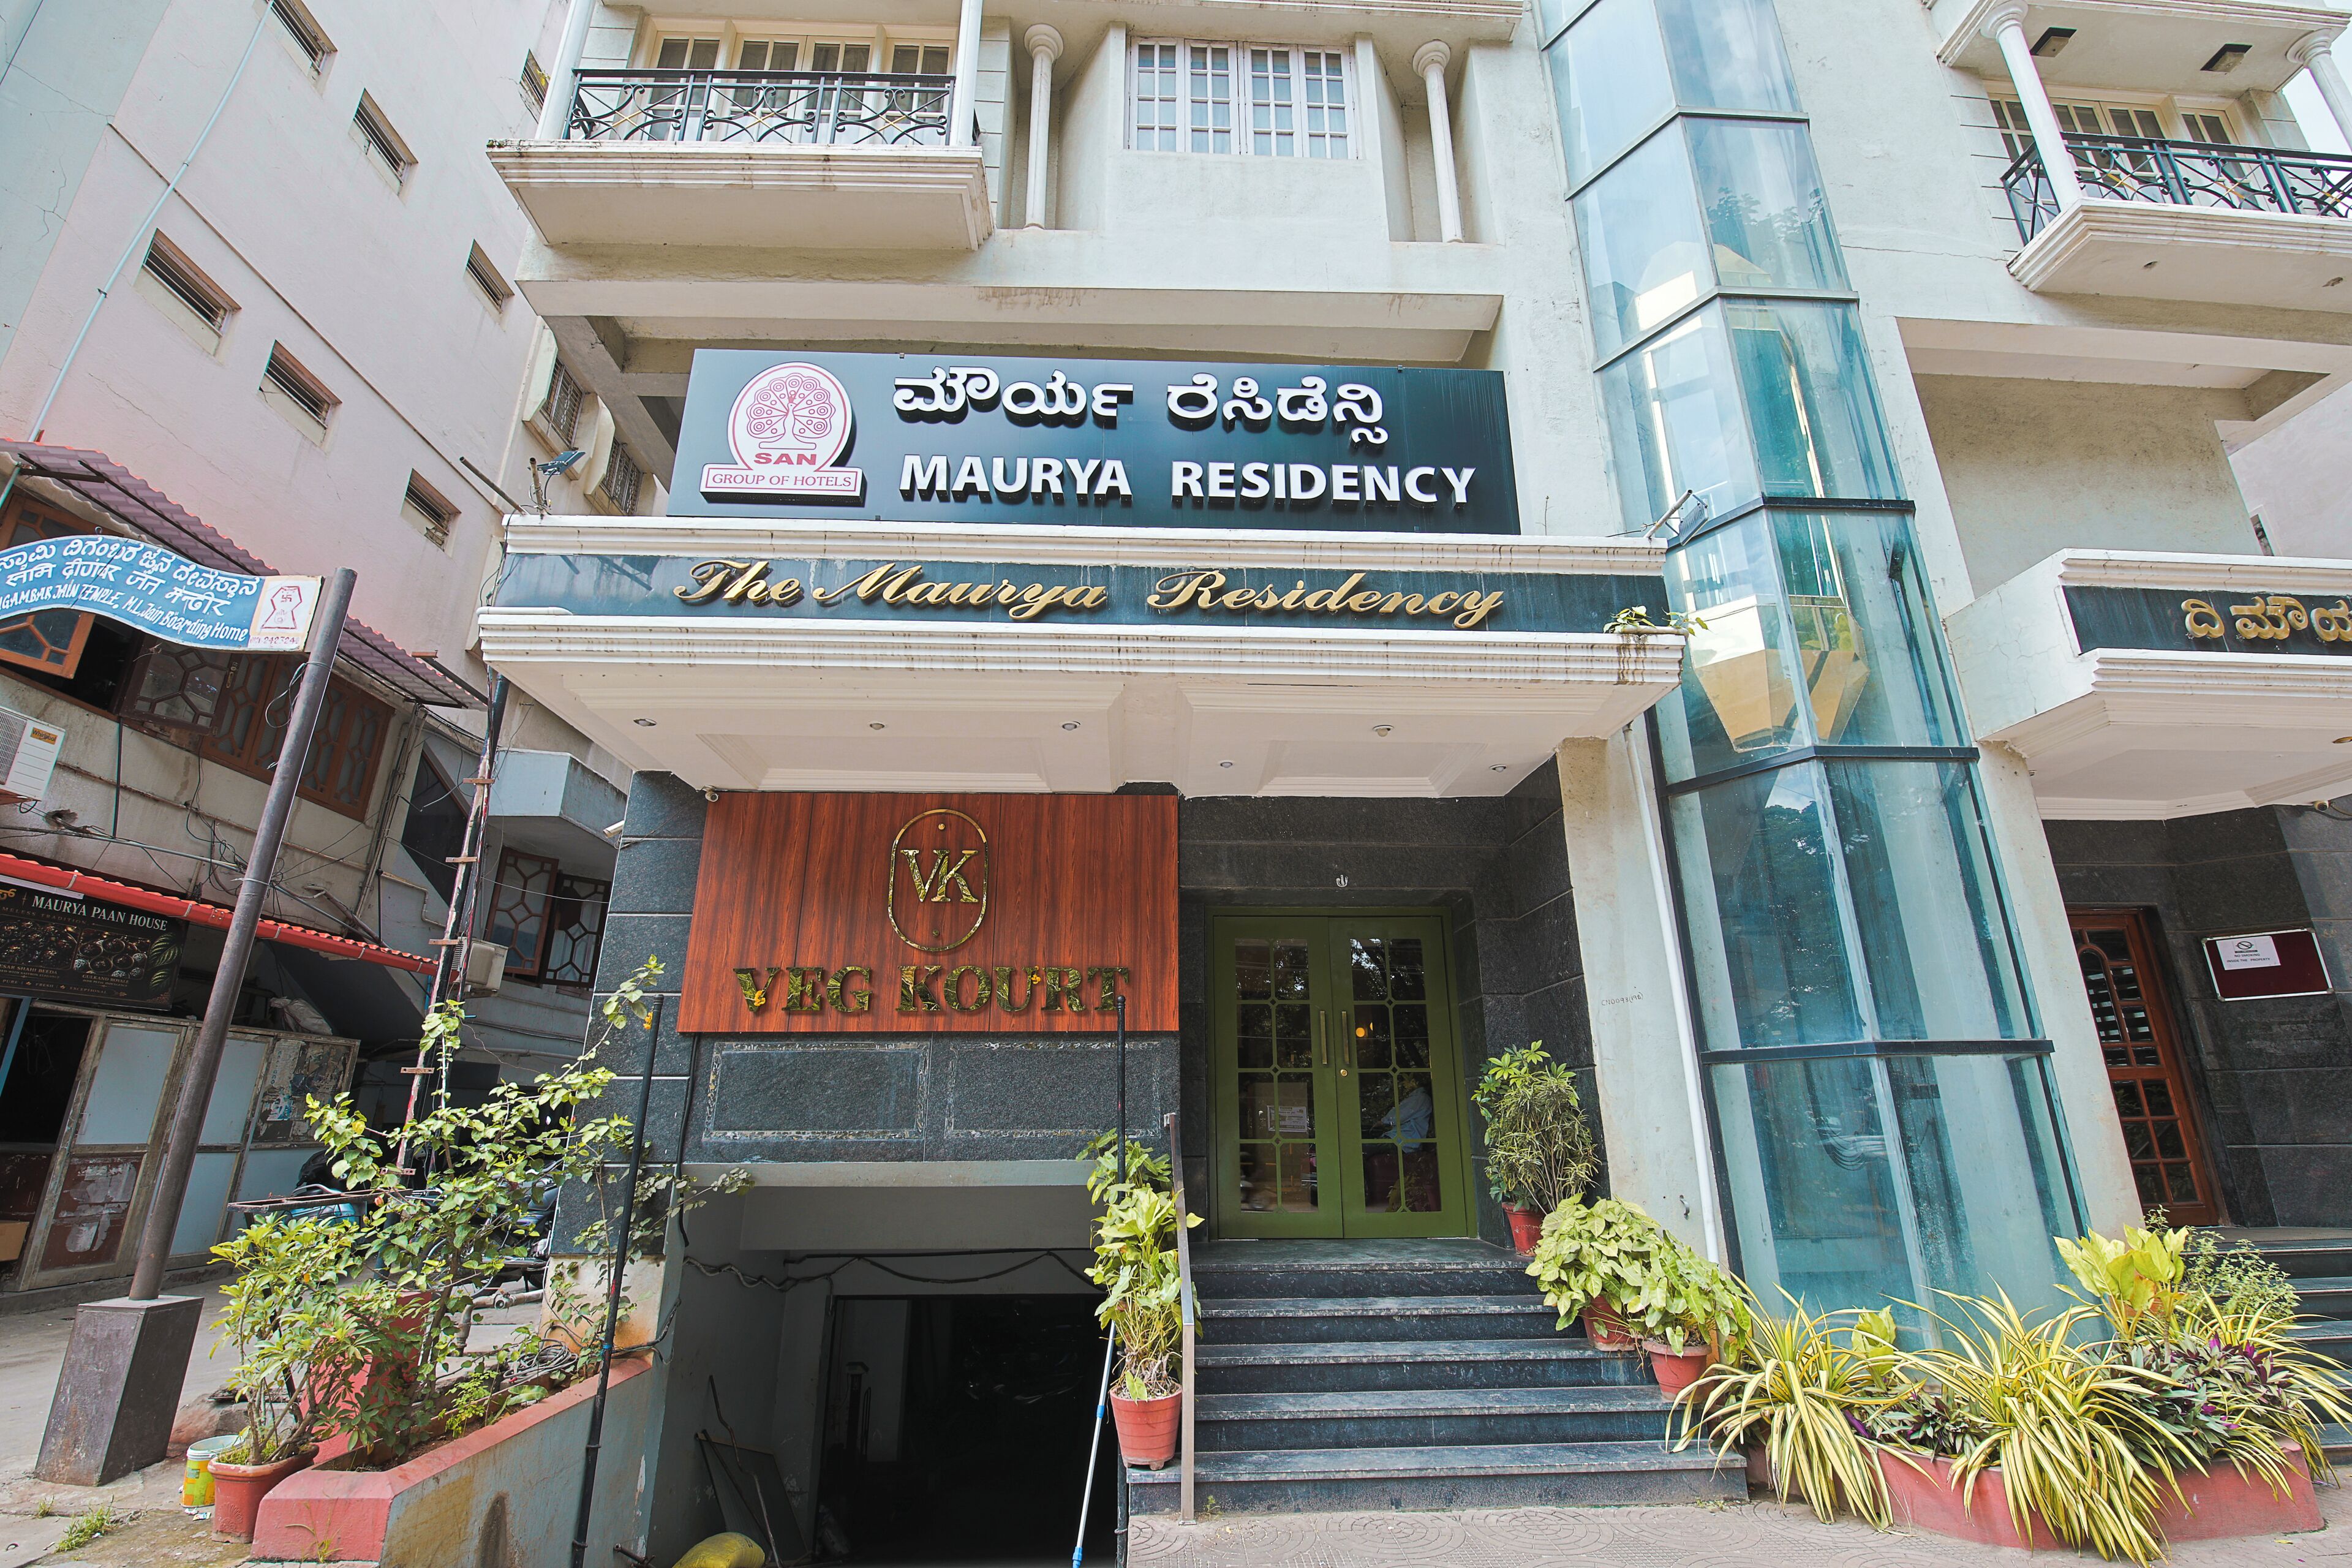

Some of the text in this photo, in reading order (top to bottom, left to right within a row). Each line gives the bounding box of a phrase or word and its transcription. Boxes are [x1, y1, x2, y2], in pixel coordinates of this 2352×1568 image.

[892, 366, 1389, 445] ಮೌರ್ಯ ರೆಸಿಡೆನ್ಸಿ
[712, 473, 852, 488] GROUP OF HOTELS
[754, 452, 816, 466] SAN
[899, 454, 1477, 505] MAURYA RESIDENCY
[52, 579, 80, 599] JAIN
[209, 621, 250, 643] Home
[673, 560, 1504, 628] The Maurya Residency
[2181, 598, 2225, 638] ದಿ
[32, 729, 56, 742] Whirlpool
[900, 848, 979, 903] VK
[32, 895, 168, 931] MAURYA PAAN HOUSE
[733, 965, 1129, 1014] VEG KOURT
